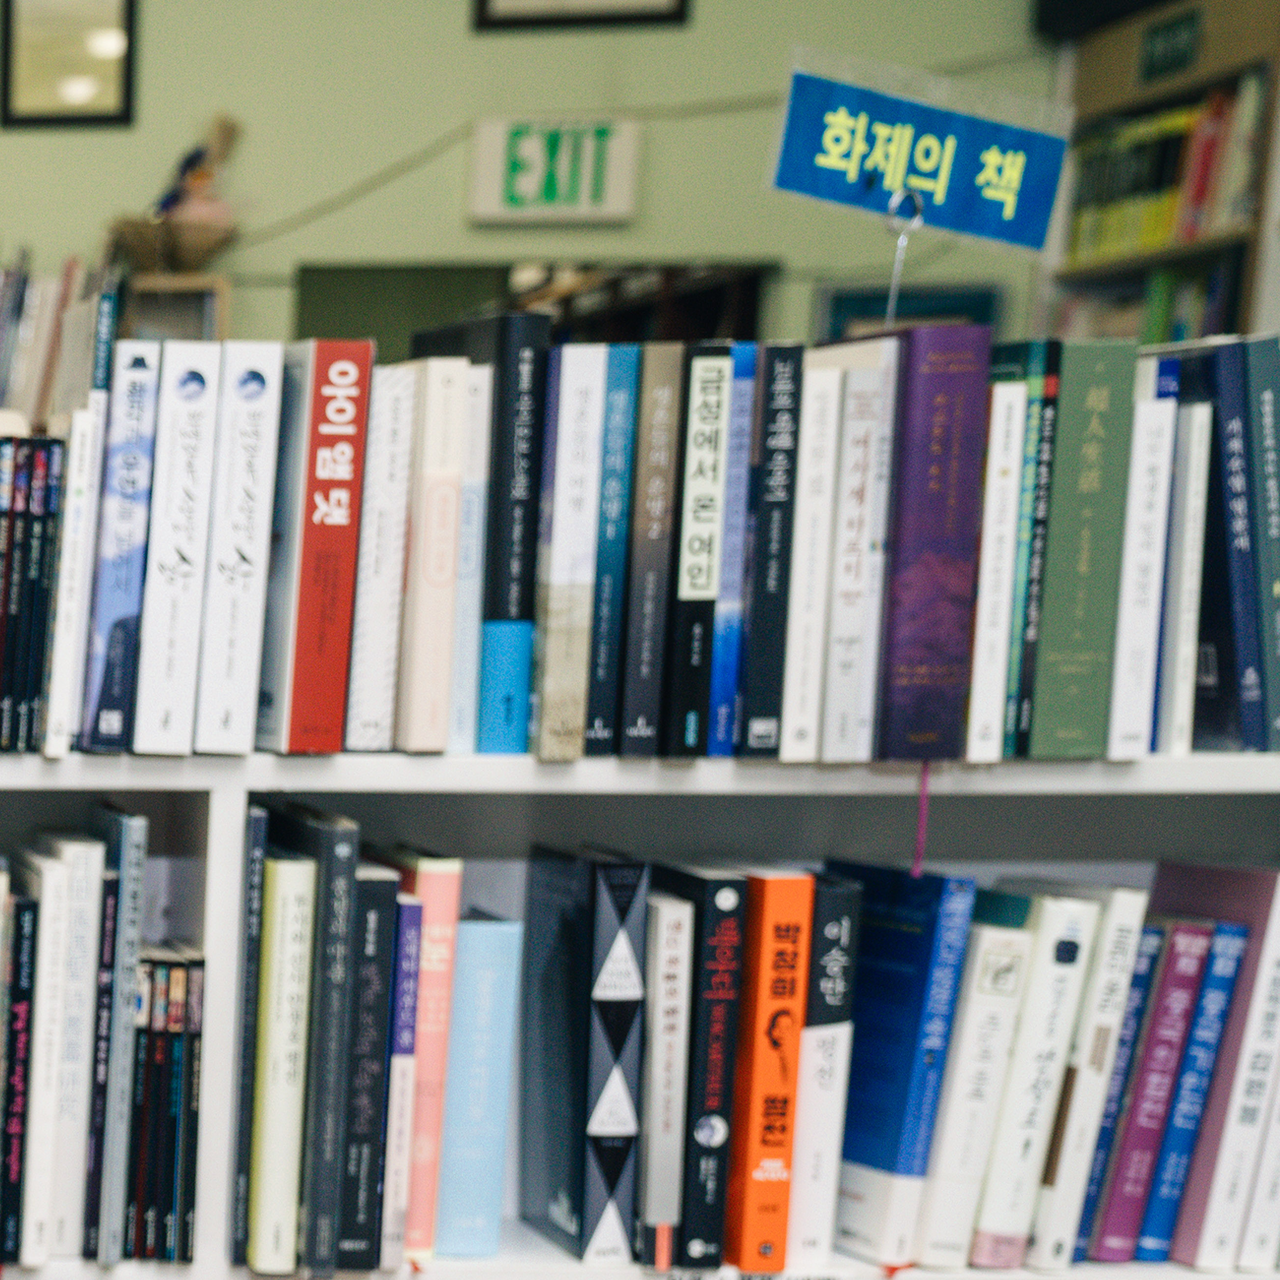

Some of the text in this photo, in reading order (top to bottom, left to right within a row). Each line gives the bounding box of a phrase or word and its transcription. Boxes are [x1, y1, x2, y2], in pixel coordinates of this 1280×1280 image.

[504, 123, 615, 207] EXIT
[816, 109, 1027, 220] 화제의 책
[319, 360, 359, 436] 아이
